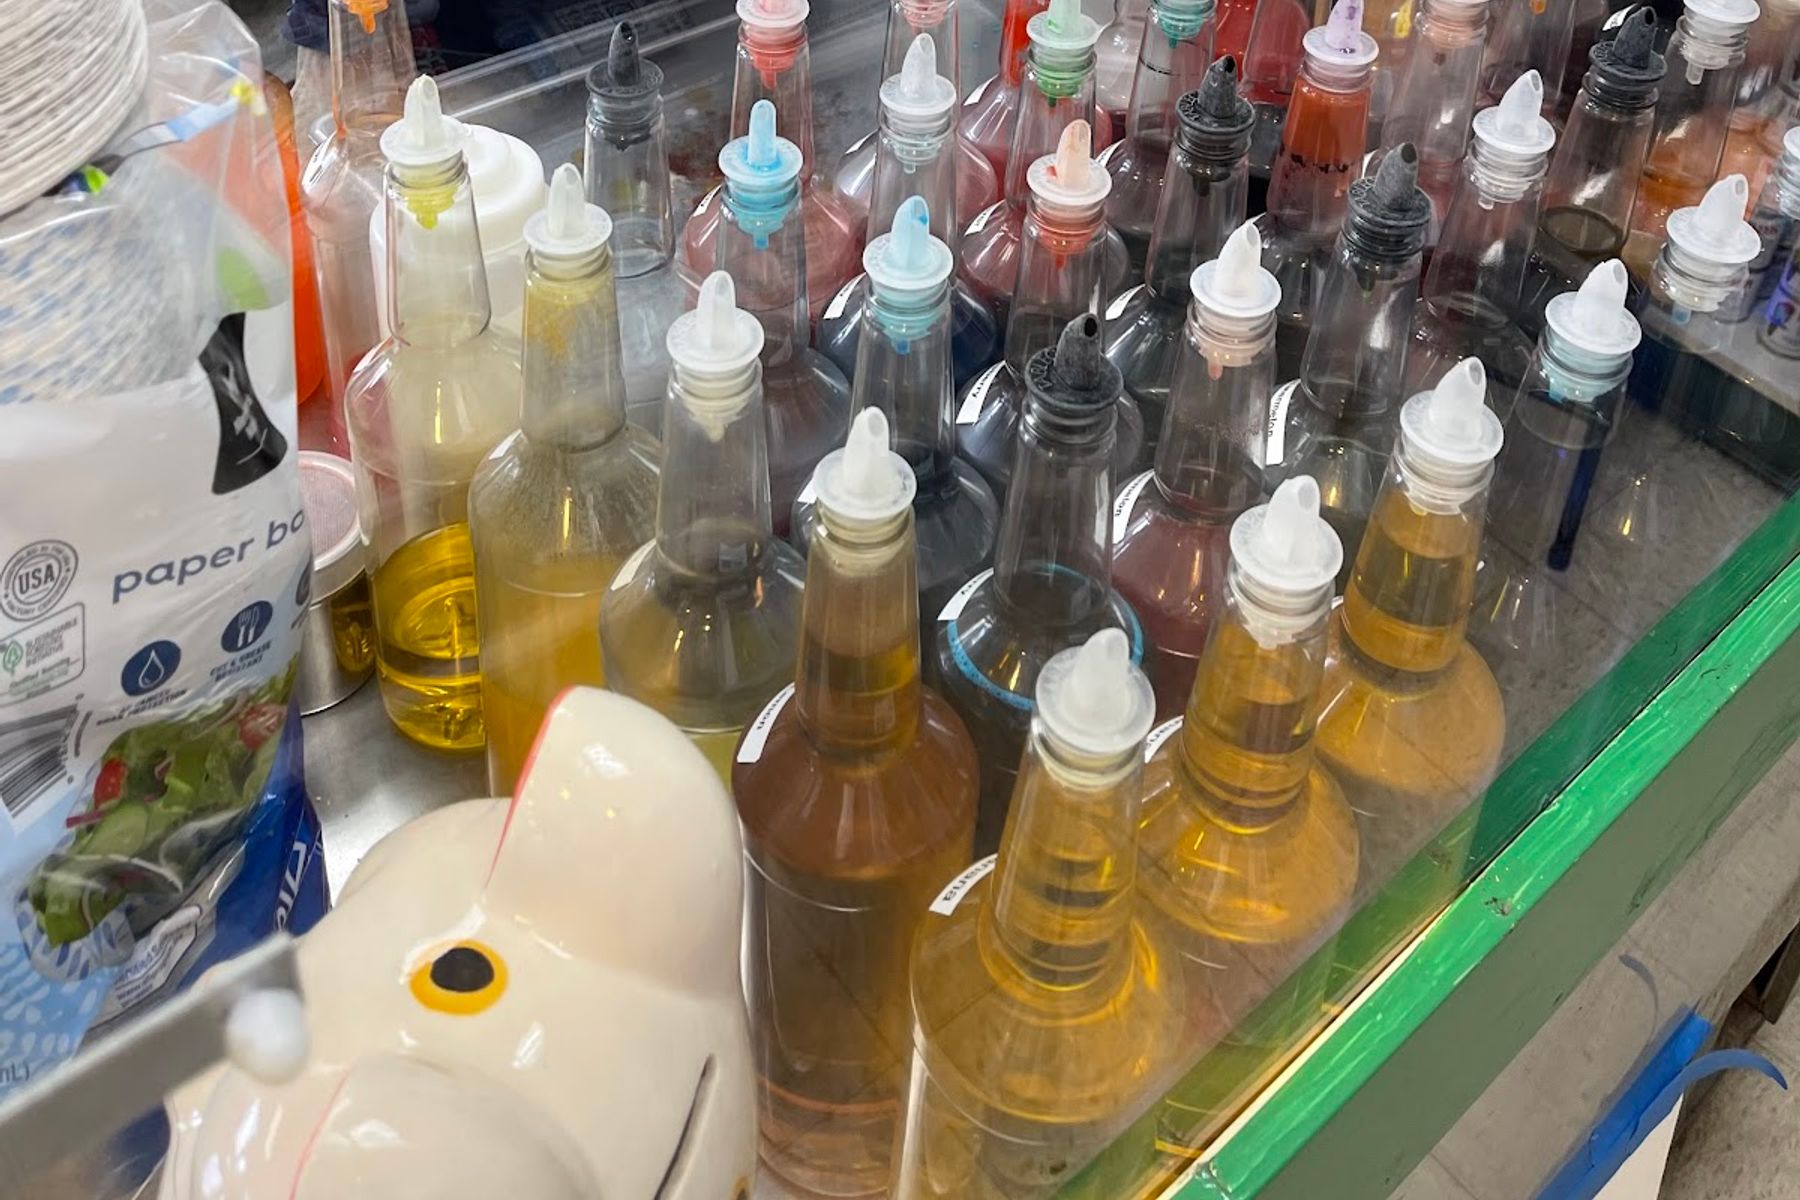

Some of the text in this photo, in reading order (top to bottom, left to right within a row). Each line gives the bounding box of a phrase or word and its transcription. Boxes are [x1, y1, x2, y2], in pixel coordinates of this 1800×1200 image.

[18, 563, 55, 595] USA
[112, 537, 255, 605] paper
[942, 858, 995, 901] anana
